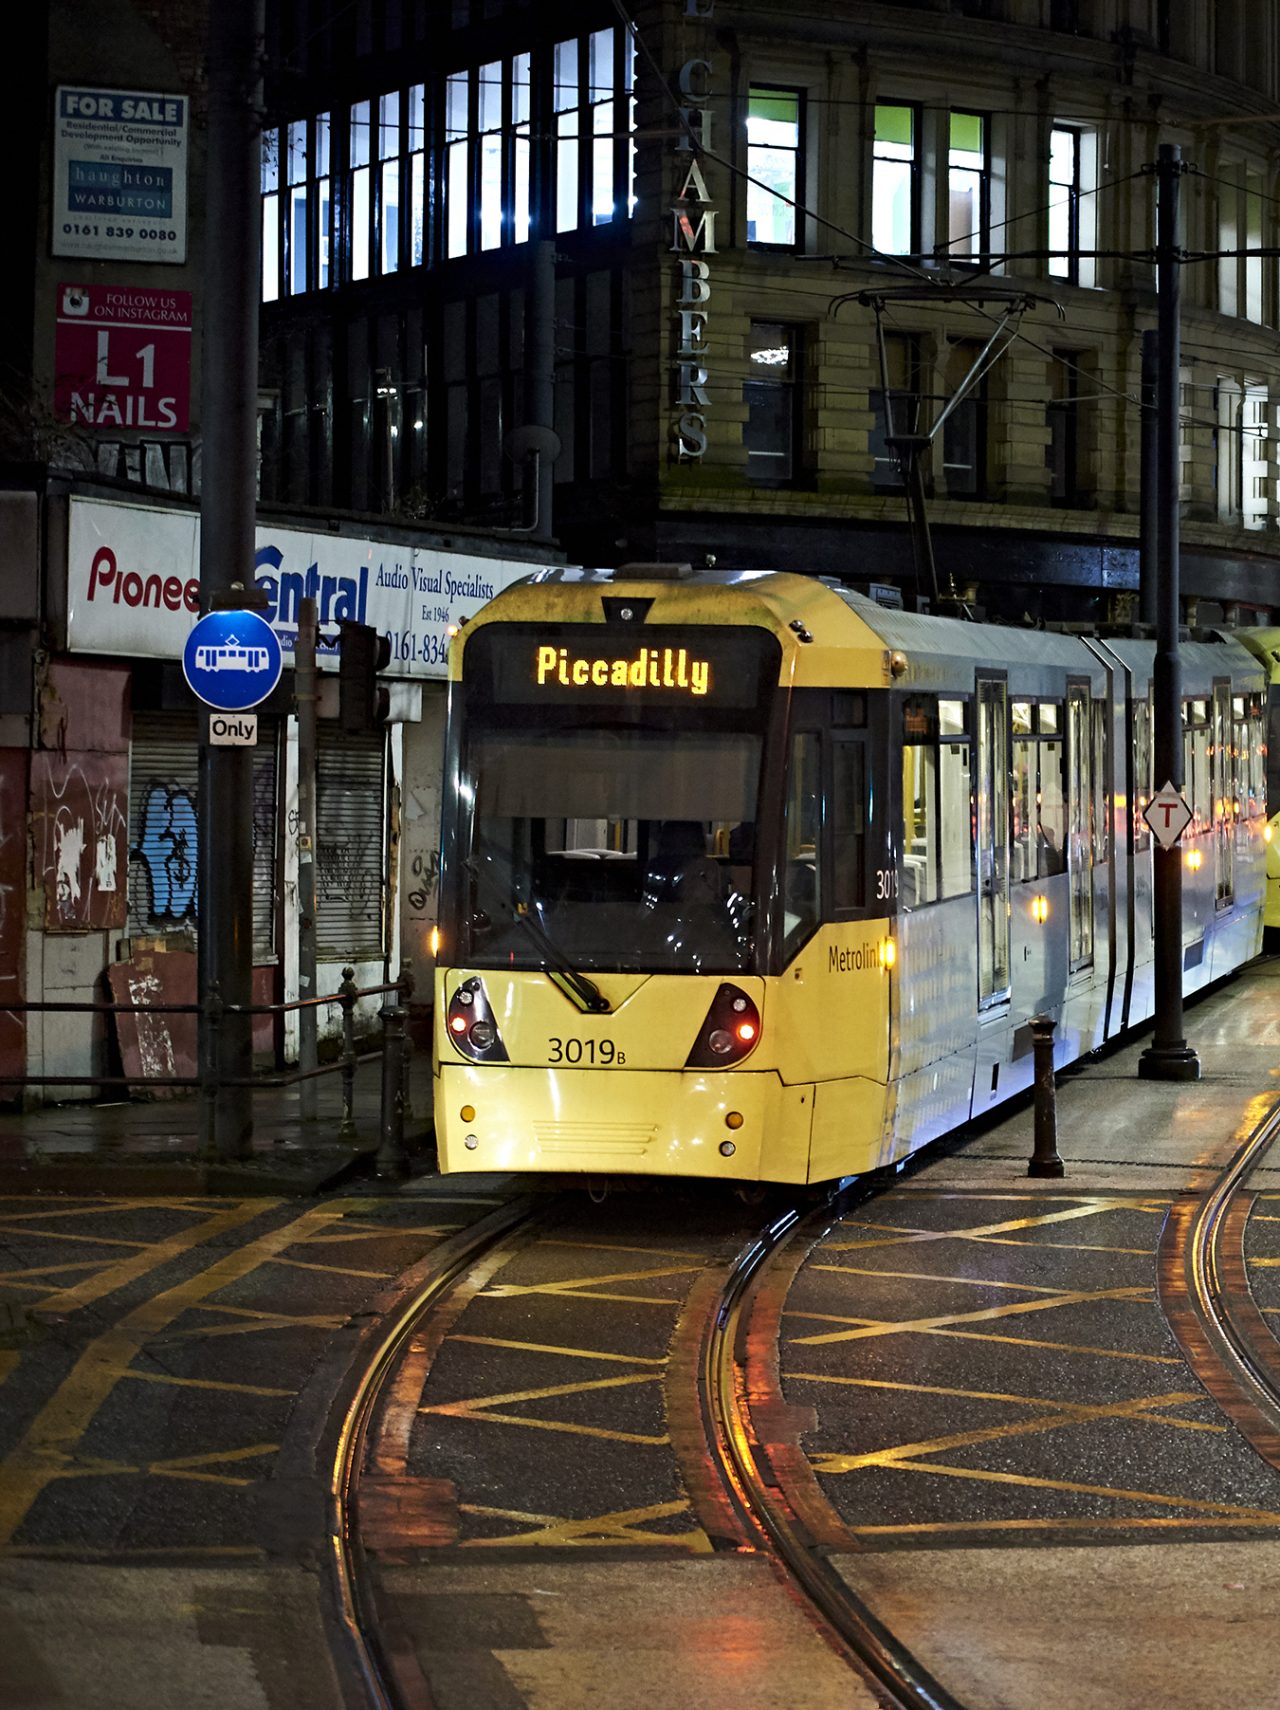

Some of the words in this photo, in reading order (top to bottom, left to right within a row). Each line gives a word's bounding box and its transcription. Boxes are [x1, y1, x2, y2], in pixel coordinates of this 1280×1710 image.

[66, 95, 114, 118] FOR
[121, 100, 178, 122] SALE
[61, 129, 124, 144] Development
[126, 134, 182, 148] Opportunity
[75, 167, 165, 188] haughton
[74, 192, 166, 209] WARBURTON
[63, 223, 99, 237] 0161
[106, 226, 135, 239] 839
[139, 228, 177, 241] 0080
[670, 58, 719, 460] CHAMBERS
[106, 293, 158, 308] FOLLOW
[160, 297, 176, 309] US
[94, 305, 114, 317] ON
[117, 308, 188, 323] INSTAGRAM
[96, 331, 155, 388] L1
[70, 391, 178, 429] NAILS
[87, 546, 200, 613] Pionee
[375, 562, 408, 590] Audio
[411, 566, 442, 594] Visual
[445, 571, 494, 603] Specialists
[422, 605, 431, 621] Est
[433, 606, 449, 623] 1946
[538, 646, 708, 694] Piccadilly
[213, 720, 254, 740] Only
[1158, 803, 1178, 828] T
[876, 870, 899, 899] 3019
